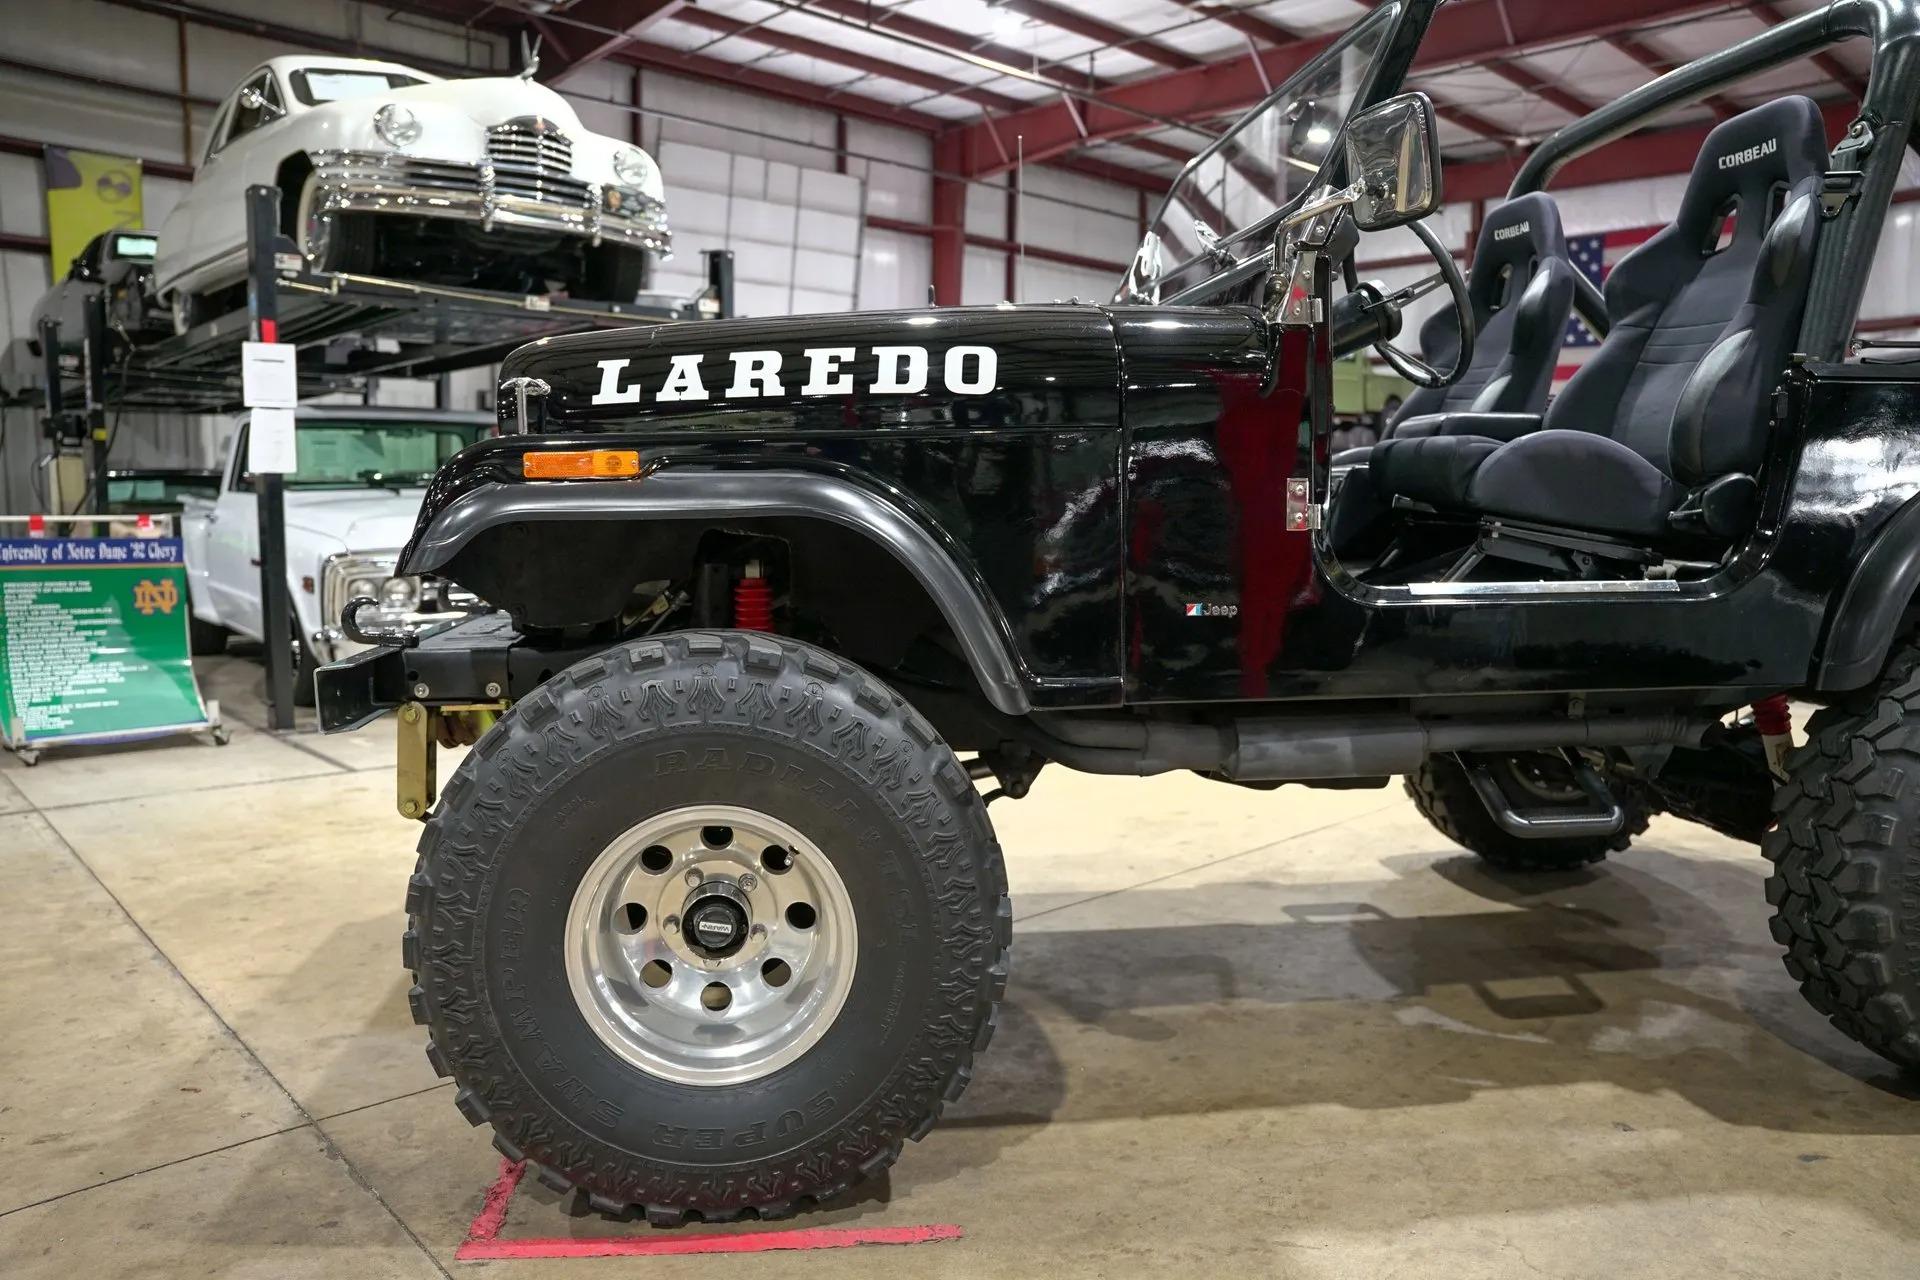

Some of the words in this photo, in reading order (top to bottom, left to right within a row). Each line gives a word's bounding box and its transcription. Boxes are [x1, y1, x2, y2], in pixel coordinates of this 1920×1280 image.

[1718, 138, 1777, 170] CORBEAU
[1494, 221, 1530, 241] CORBEAU
[591, 345, 998, 405] LAREDO
[0, 543, 48, 563] niversity
[52, 543, 63, 561] of
[67, 542, 96, 561] Notre
[99, 541, 127, 561] Dame
[148, 541, 177, 562] Chevy
[1202, 603, 1238, 618] Jeep
[652, 1089, 839, 1150] SUPER
